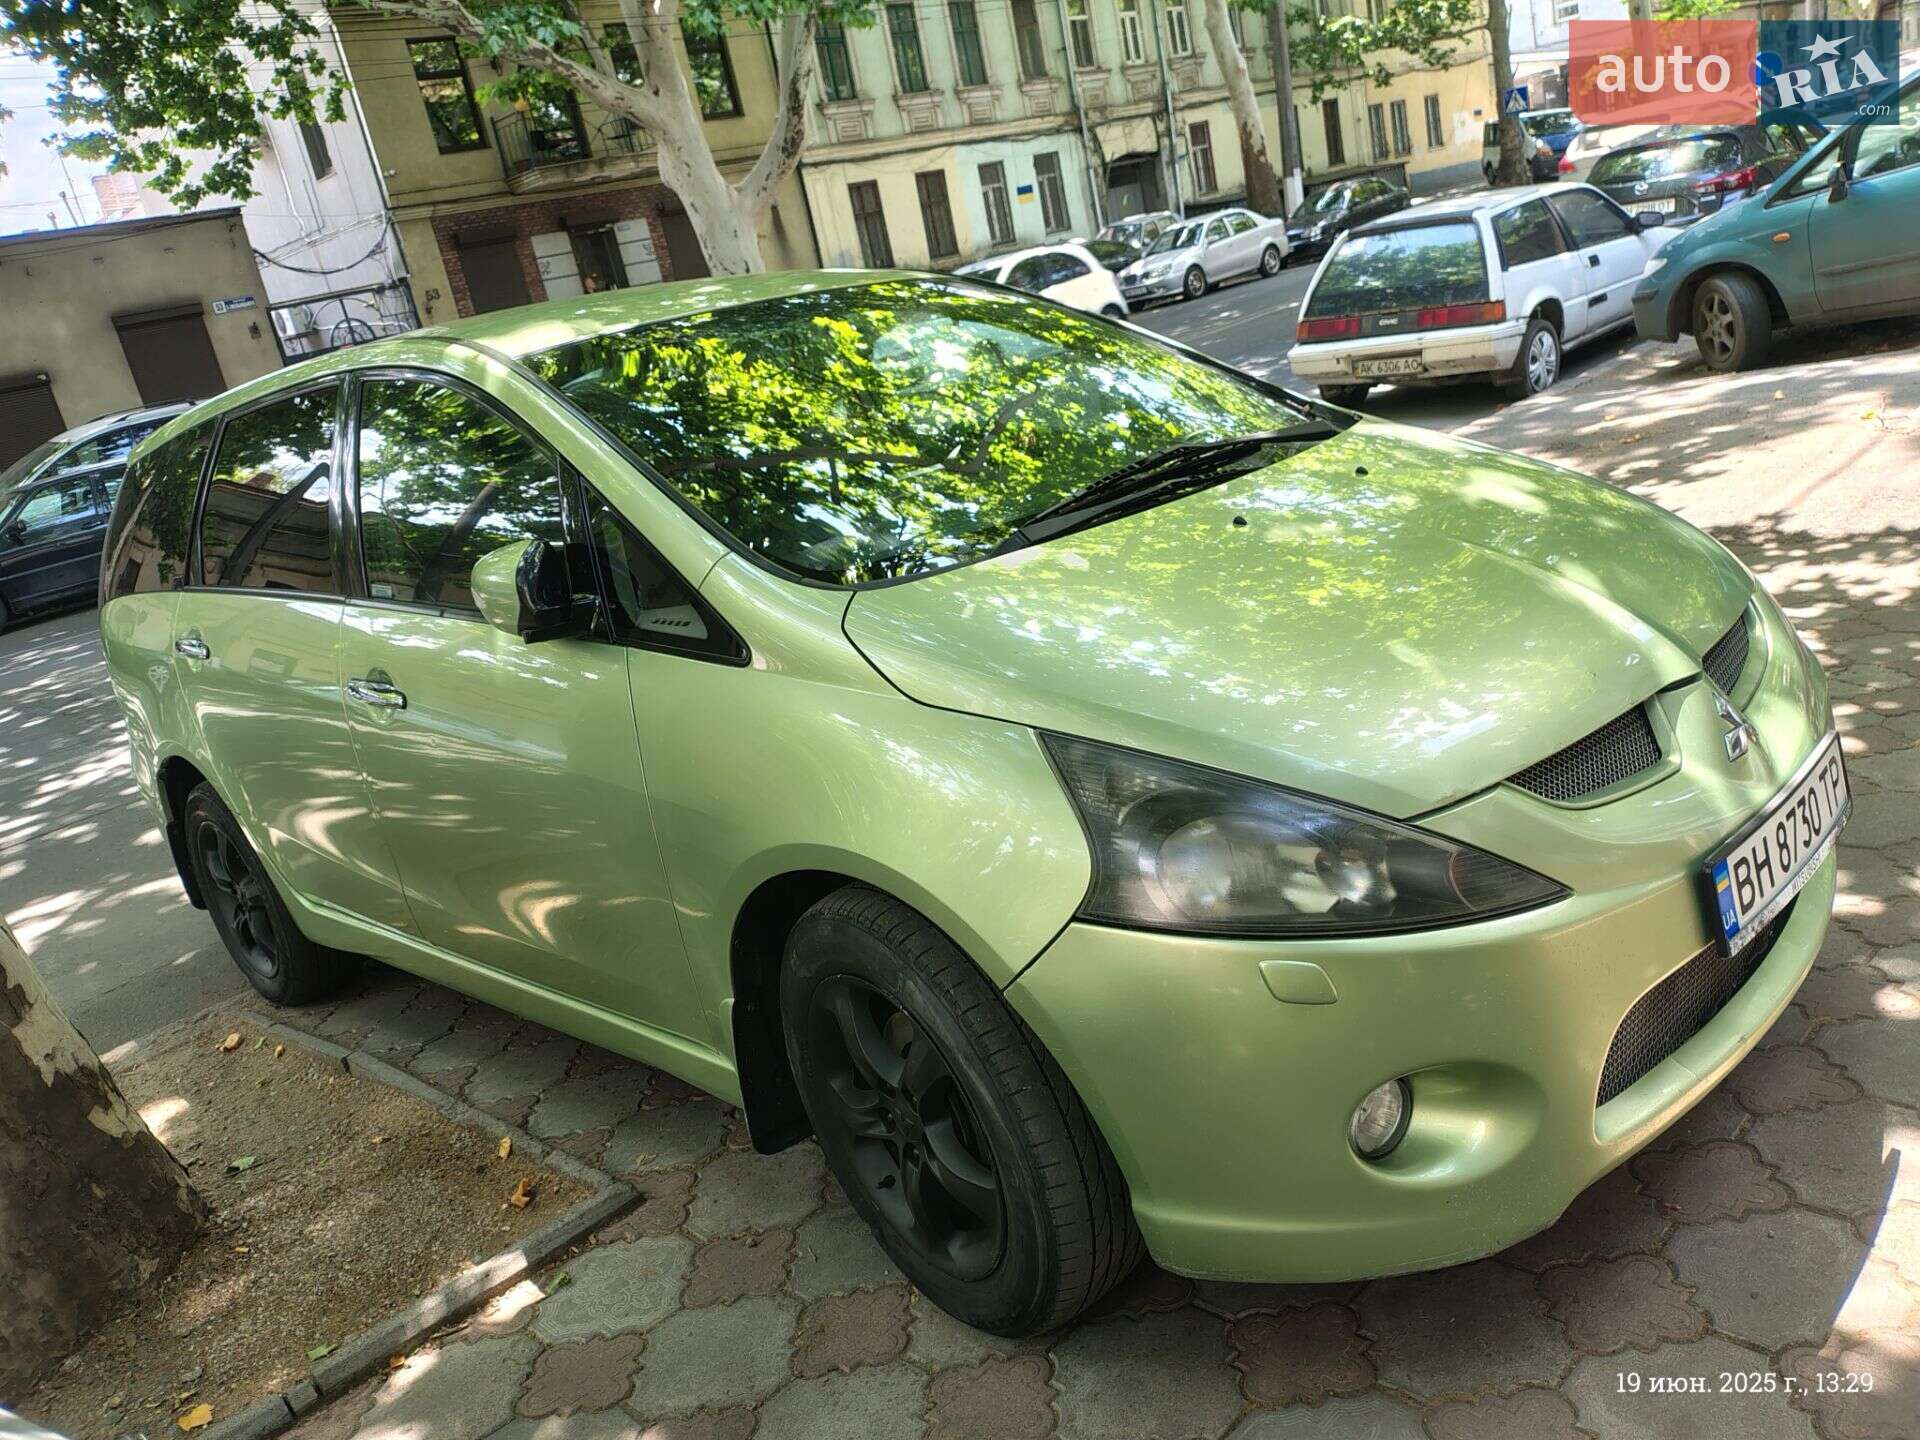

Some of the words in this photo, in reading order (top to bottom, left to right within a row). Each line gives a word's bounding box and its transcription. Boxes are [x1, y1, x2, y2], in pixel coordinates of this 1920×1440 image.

[1732, 835, 1776, 918] BH
[1775, 785, 1822, 874] 8730
[1819, 755, 1841, 818] TP
[1722, 910, 1737, 930] UA
